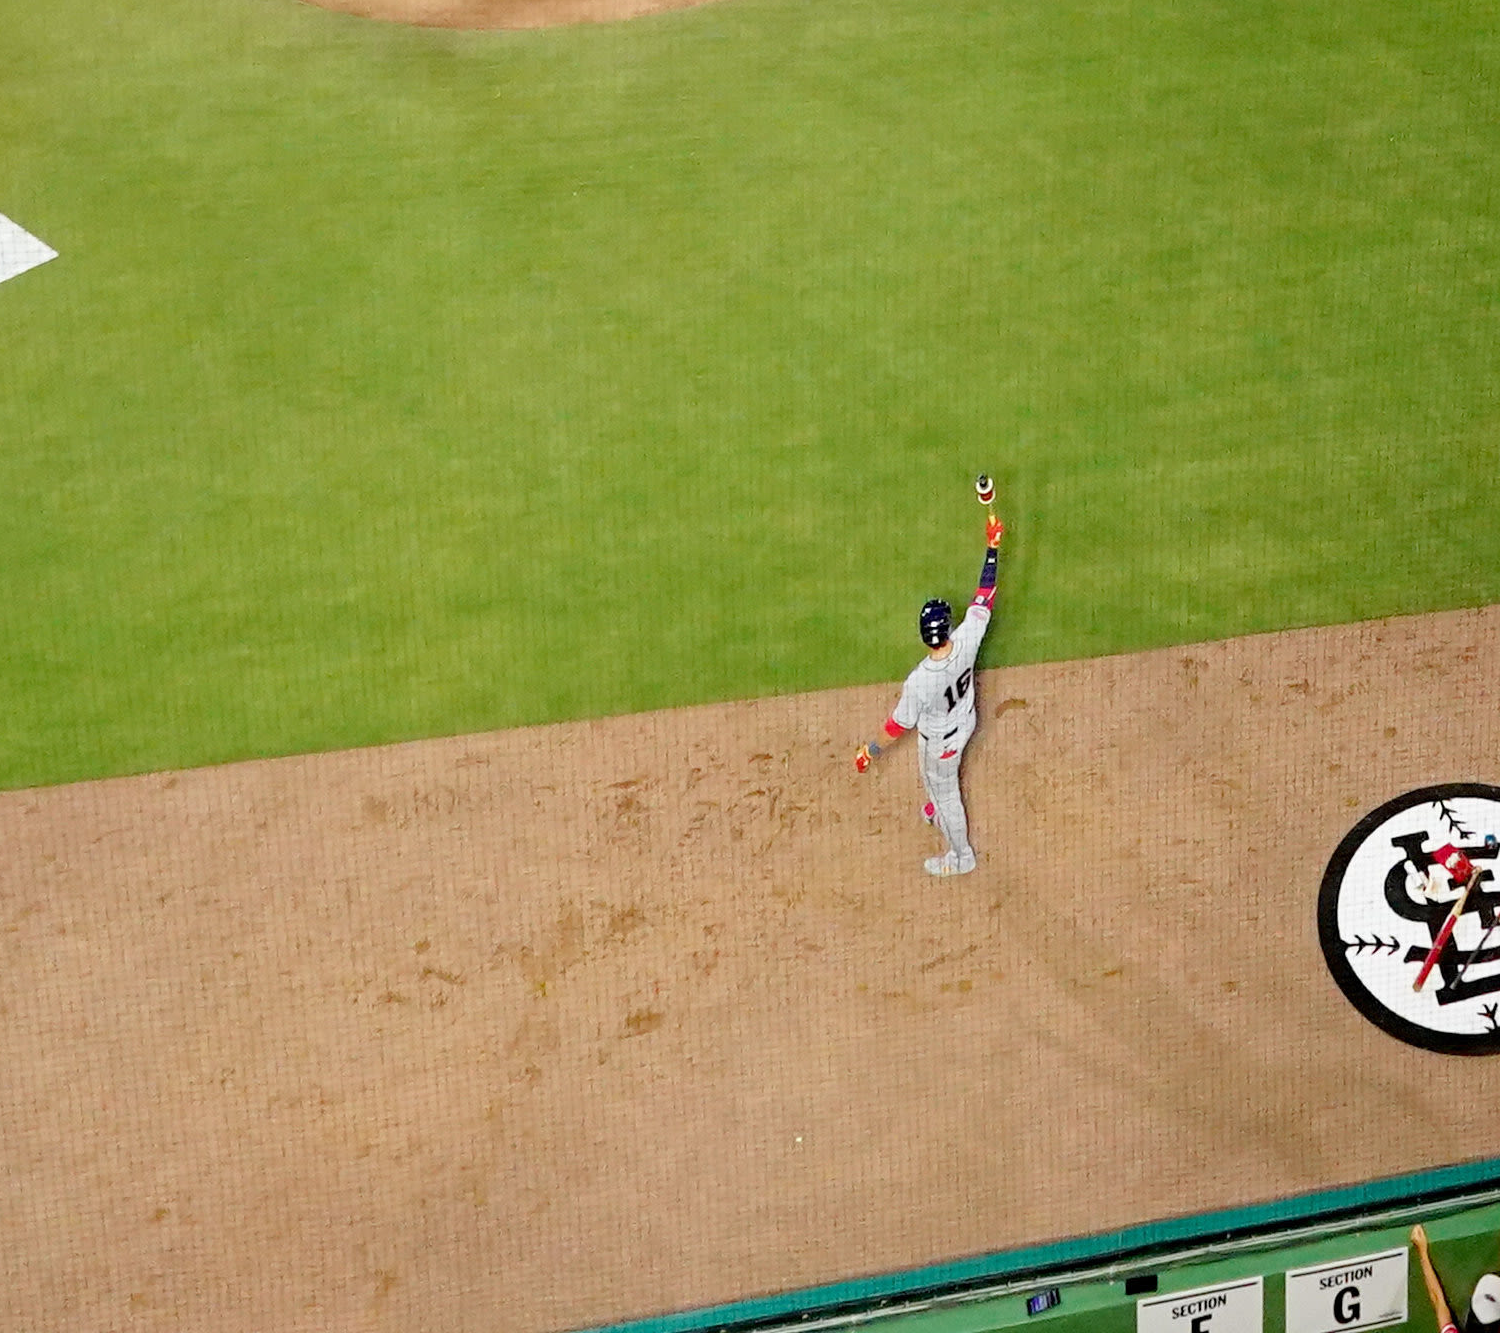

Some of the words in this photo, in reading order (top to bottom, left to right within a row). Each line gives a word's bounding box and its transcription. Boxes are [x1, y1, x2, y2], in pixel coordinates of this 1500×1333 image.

[942, 667, 973, 714] 16
[1319, 1265, 1373, 1290] SECTION
[1171, 1294, 1228, 1320] SECTION
[1332, 1286, 1361, 1324] G
